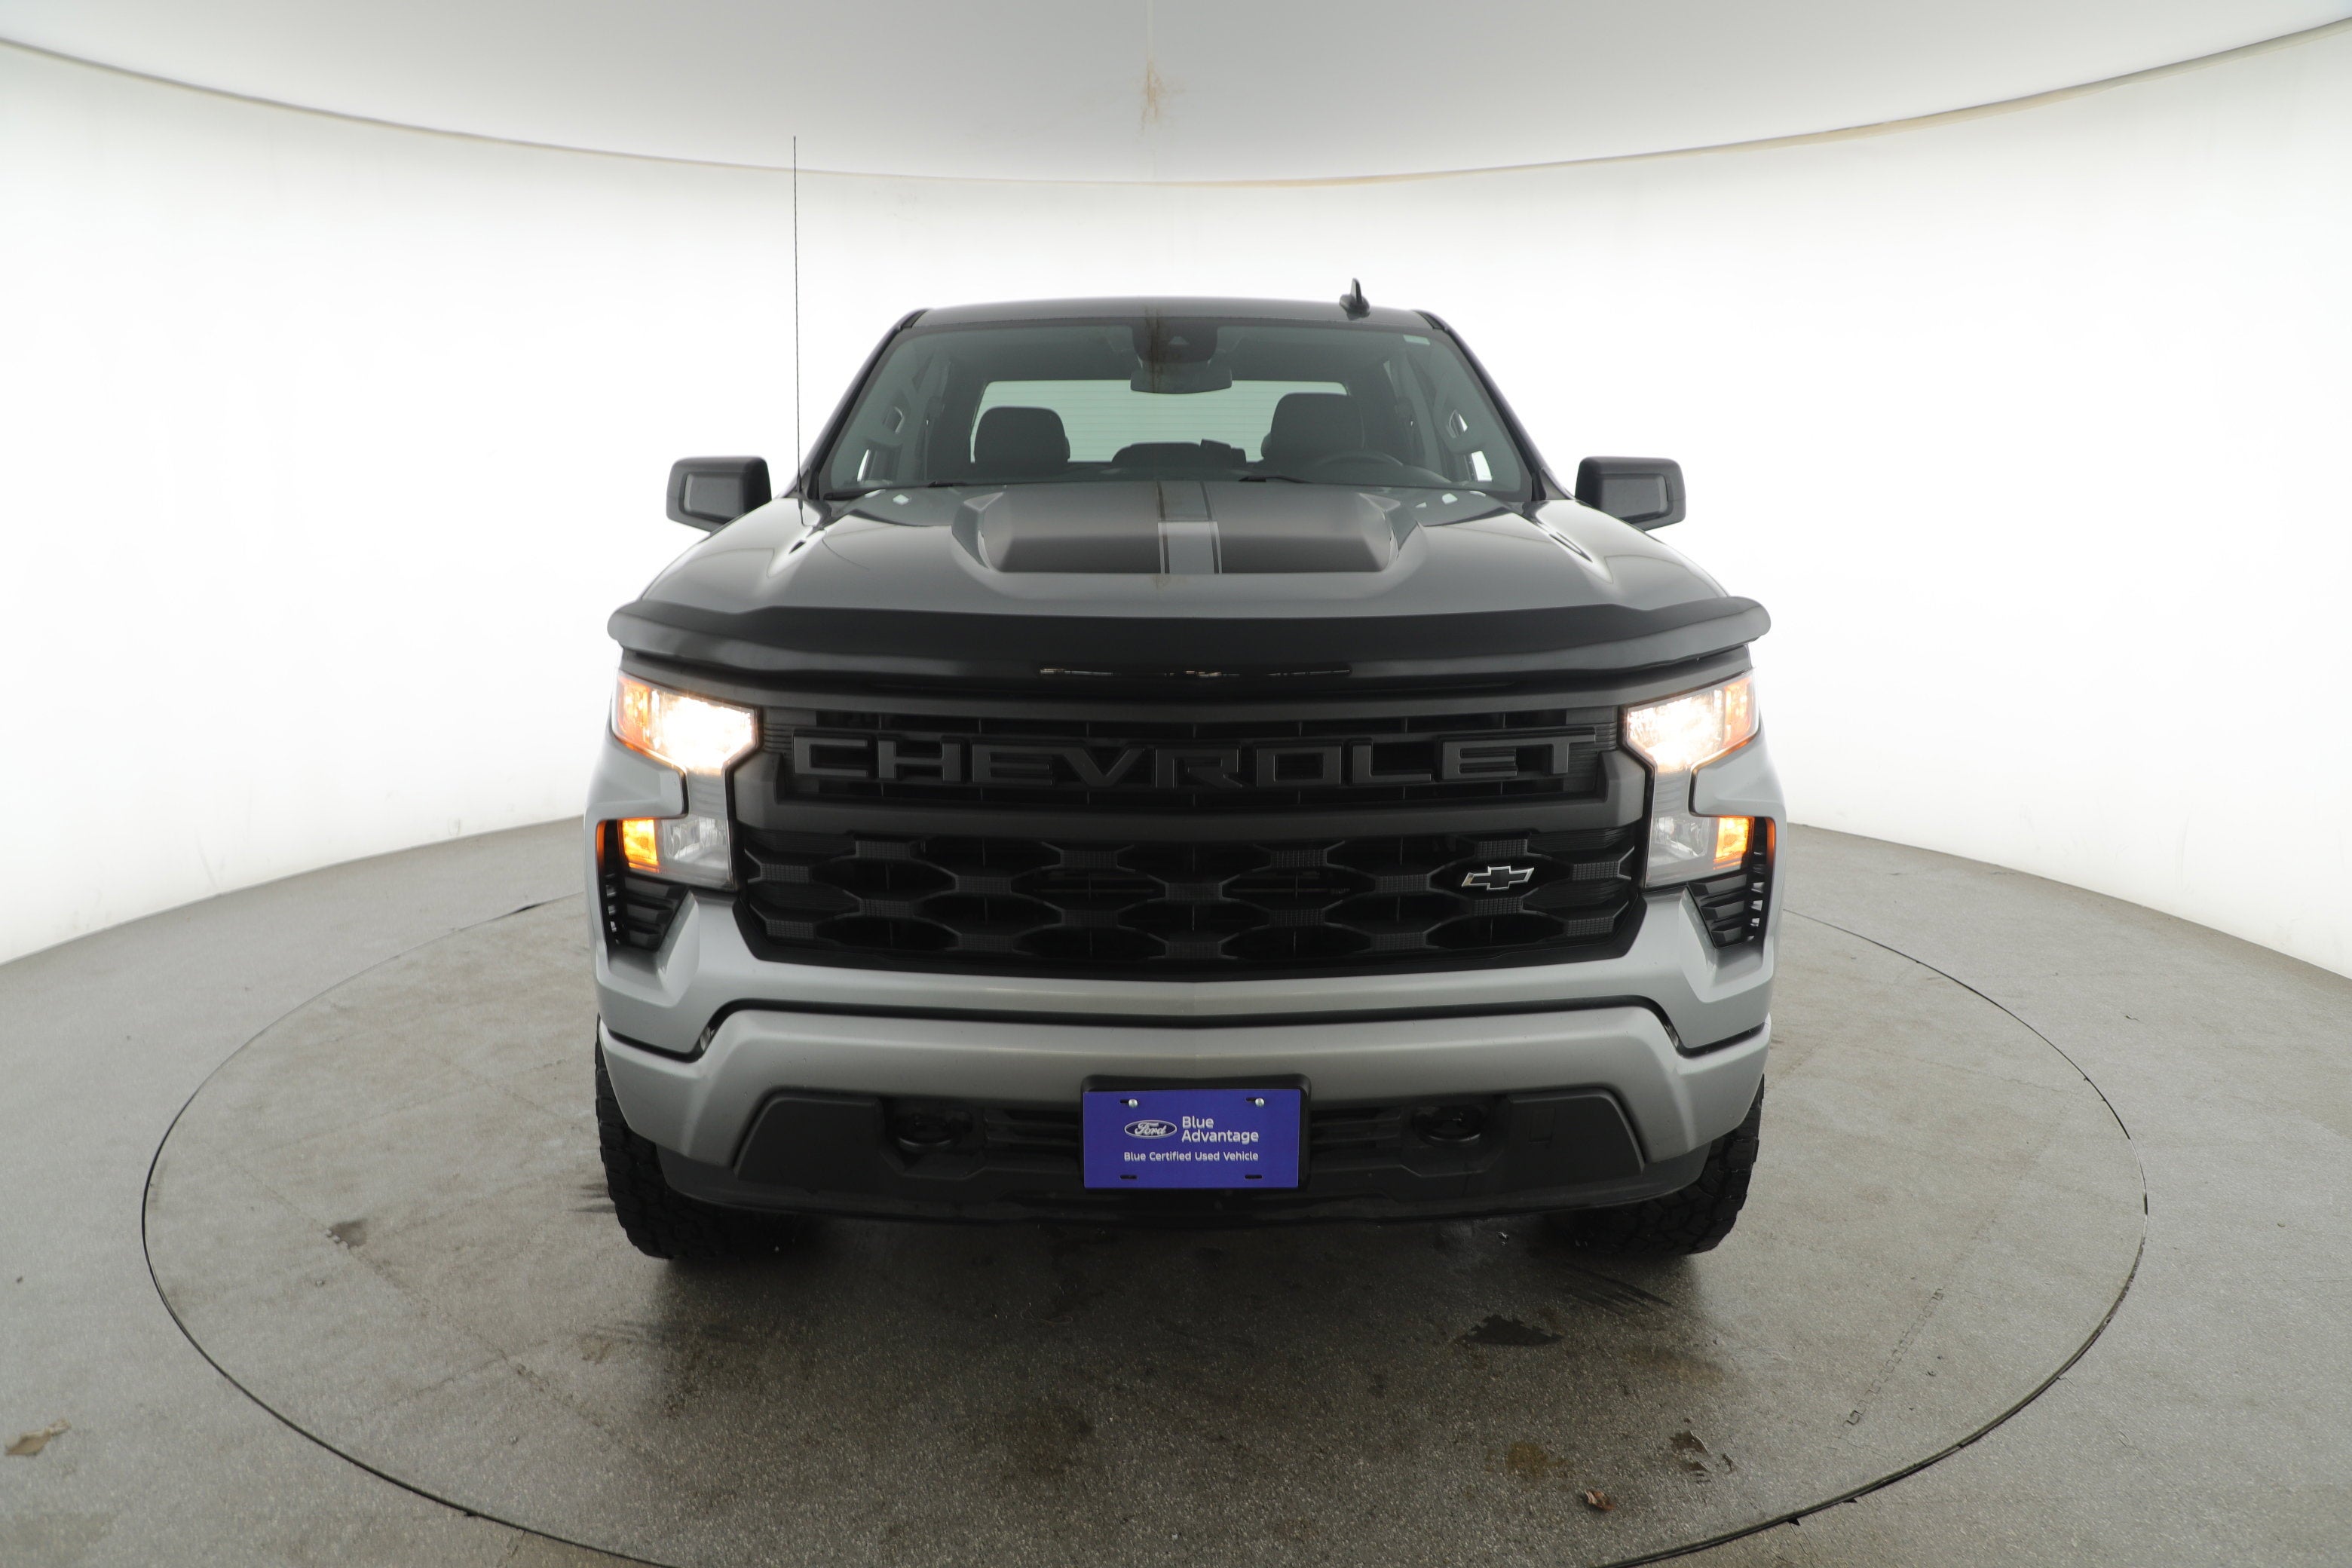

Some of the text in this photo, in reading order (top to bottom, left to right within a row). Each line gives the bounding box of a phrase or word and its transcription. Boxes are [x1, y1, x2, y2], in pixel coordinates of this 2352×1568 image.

[792, 730, 1596, 789] CHEVROLET
[1134, 1122, 1167, 1136] Ford
[1181, 1116, 1214, 1129] Blue
[1181, 1129, 1260, 1145] Advantage
[1123, 1151, 1259, 1162] Blue Certified Used Vehicle
